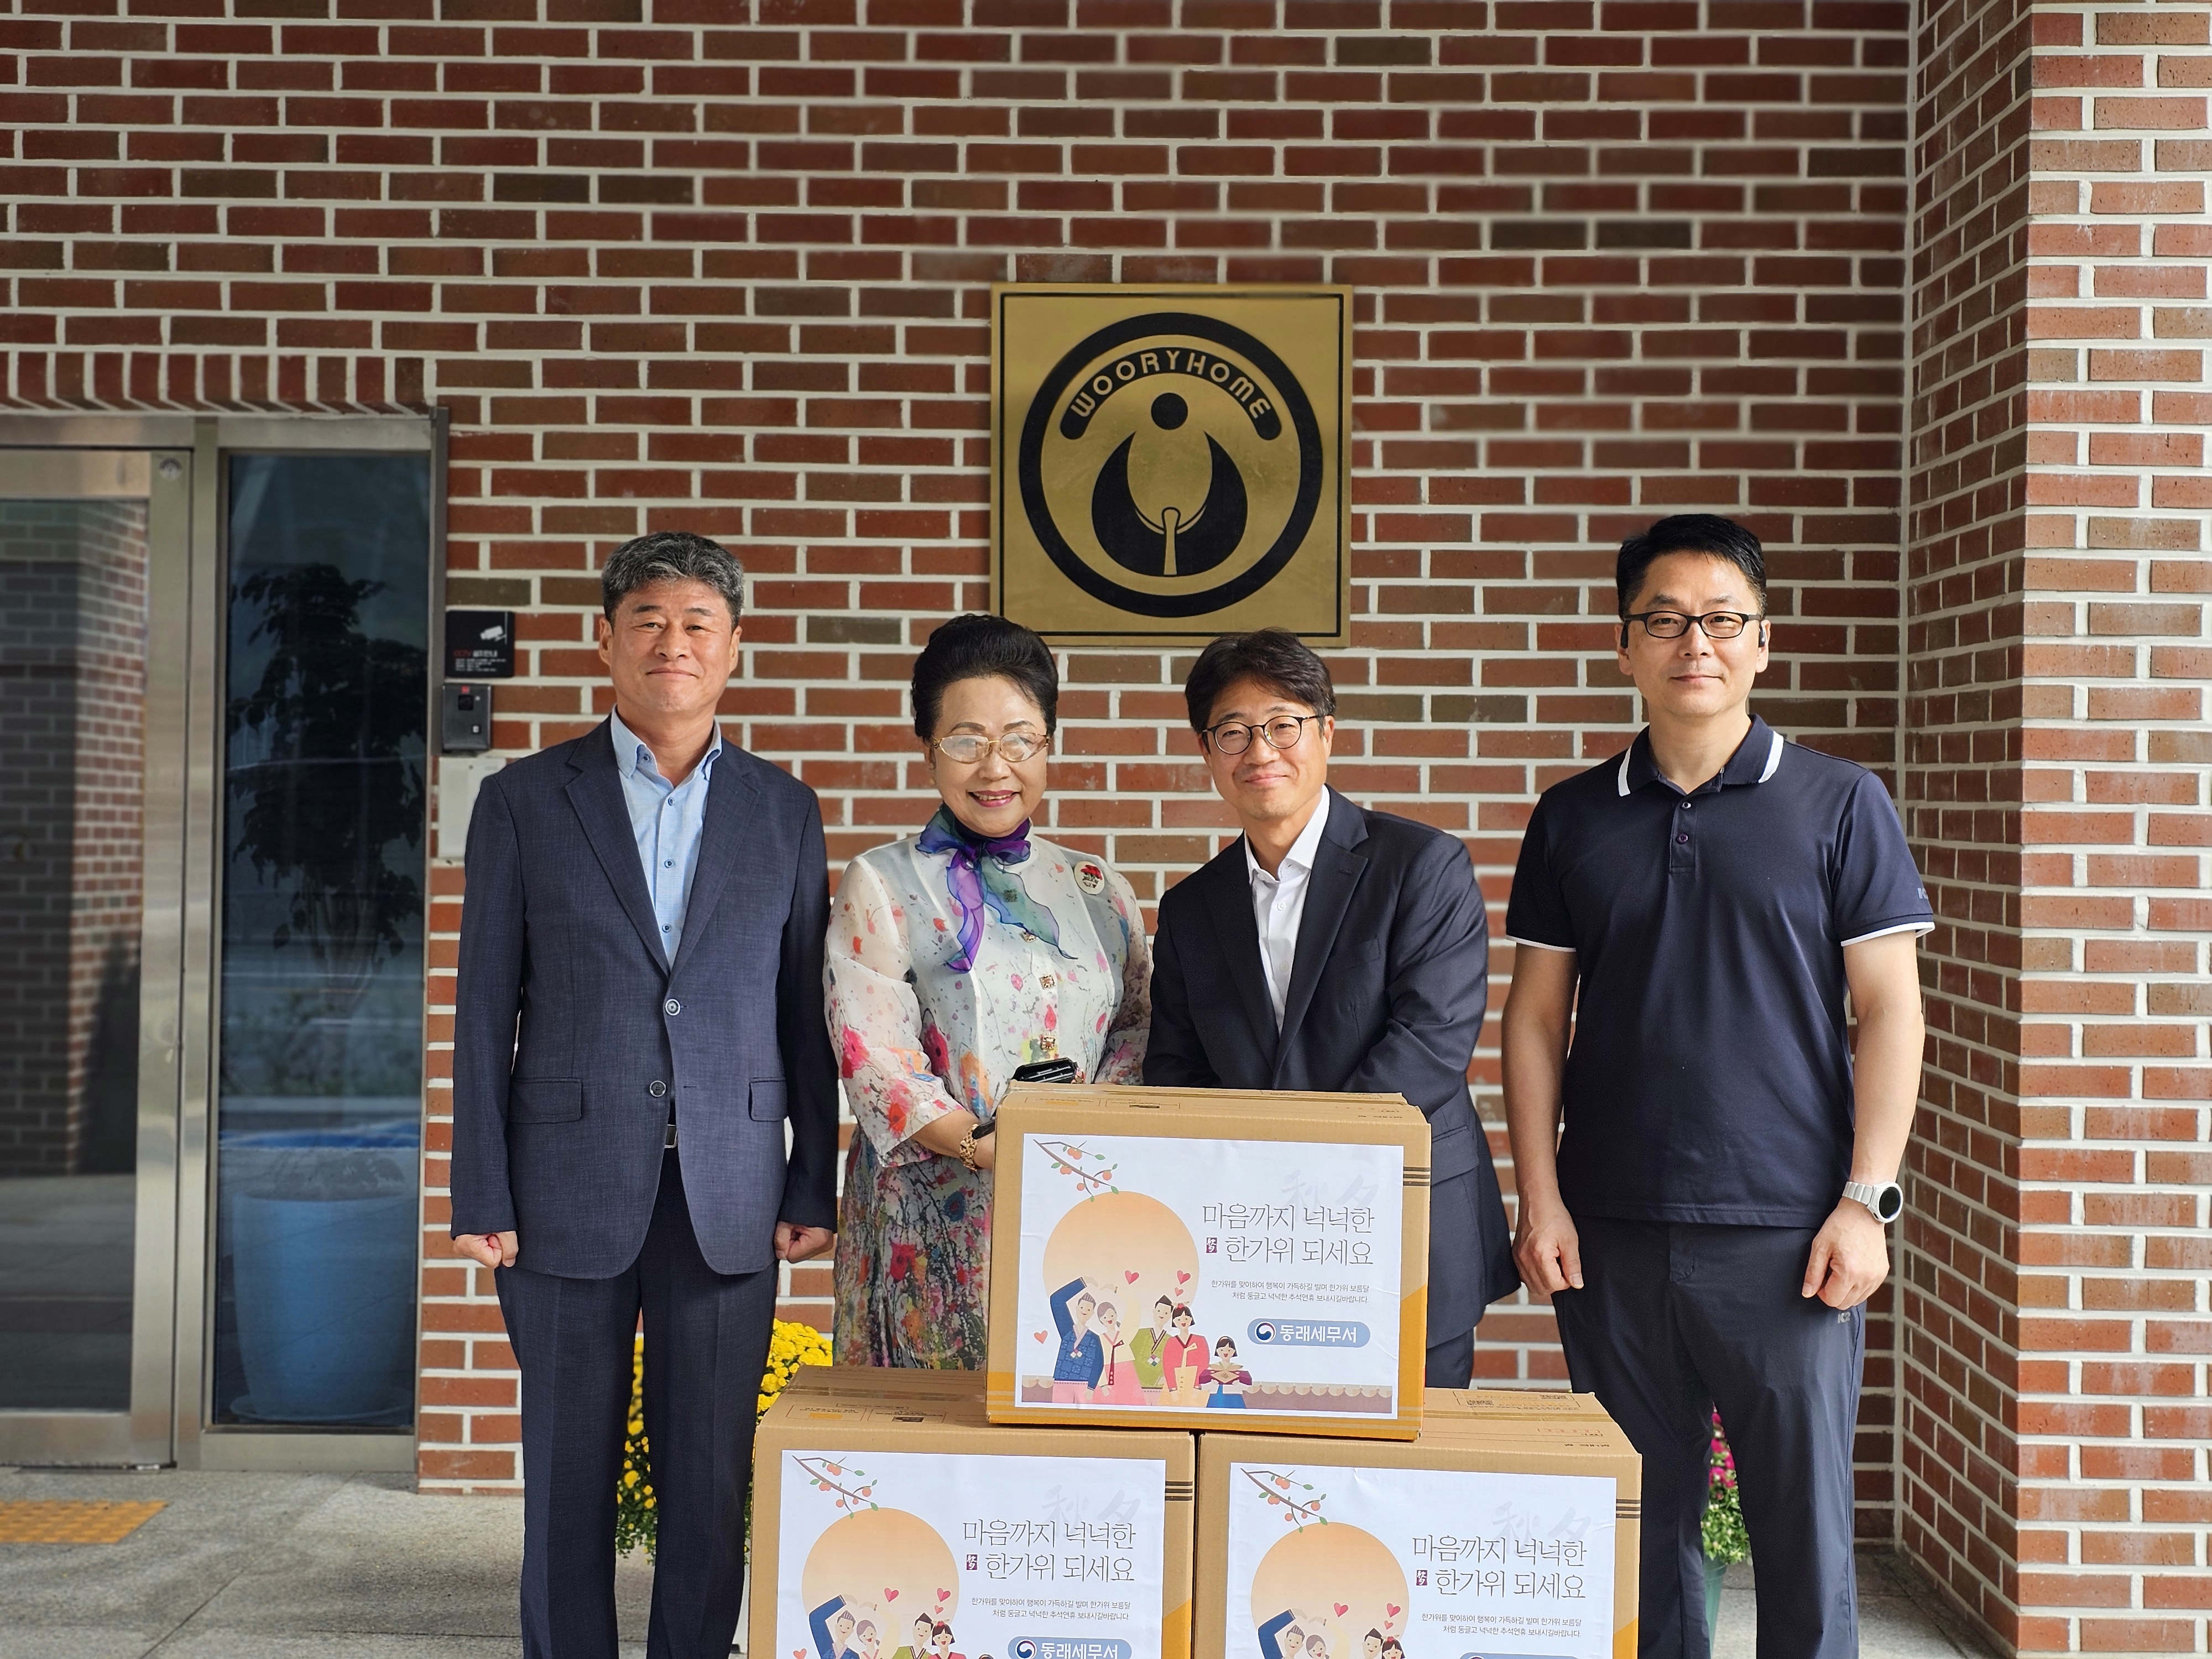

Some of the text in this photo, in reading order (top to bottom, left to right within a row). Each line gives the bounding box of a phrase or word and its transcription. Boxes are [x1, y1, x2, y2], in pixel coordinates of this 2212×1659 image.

[1071, 350, 1271, 419] WOORYHOME
[1202, 1202, 1375, 1233] 마음까지 넉넉한
[1224, 1236, 1374, 1266] 한가위 되세요
[1212, 1280, 1237, 1288] 한가위를
[1266, 1281, 1285, 1290] 행복이
[1329, 1284, 1348, 1292] 한가위
[1232, 1291, 1245, 1300] 처럼
[1247, 1292, 1266, 1300] 둥글고
[1289, 1293, 1314, 1302] 추석연휴
[1280, 1324, 1357, 1343] 동래세무서
[963, 1519, 1136, 1550] 마음까지 넉넉한
[1412, 1534, 1587, 1567] 마음까지 넉넉한
[985, 1553, 1135, 1583] 한가위 되세요
[1435, 1568, 1586, 1600] 한가위 되세요
[972, 1597, 998, 1606] 한가위를
[1026, 1599, 1046, 1607] 행복이
[1048, 1599, 1074, 1608] 가득하길
[1076, 1600, 1088, 1609] 빌며
[1091, 1601, 1109, 1609] 한가위
[1112, 1601, 1131, 1610] 보름달
[993, 1609, 1006, 1618] 처럼
[1029, 1610, 1048, 1619] 넉넉한
[1050, 1610, 1076, 1619] 추석연휴
[1422, 1613, 1447, 1621] 한가위를
[1478, 1615, 1496, 1623] 행복이
[1499, 1616, 1524, 1624] 가득하길
[1541, 1618, 1560, 1626] 한가위
[1562, 1618, 1582, 1626] 보름달
[1480, 1626, 1499, 1635] 넉넉한
[1500, 1627, 1526, 1635] 추석연휴
[1041, 1643, 1118, 1659] 동래세무서
